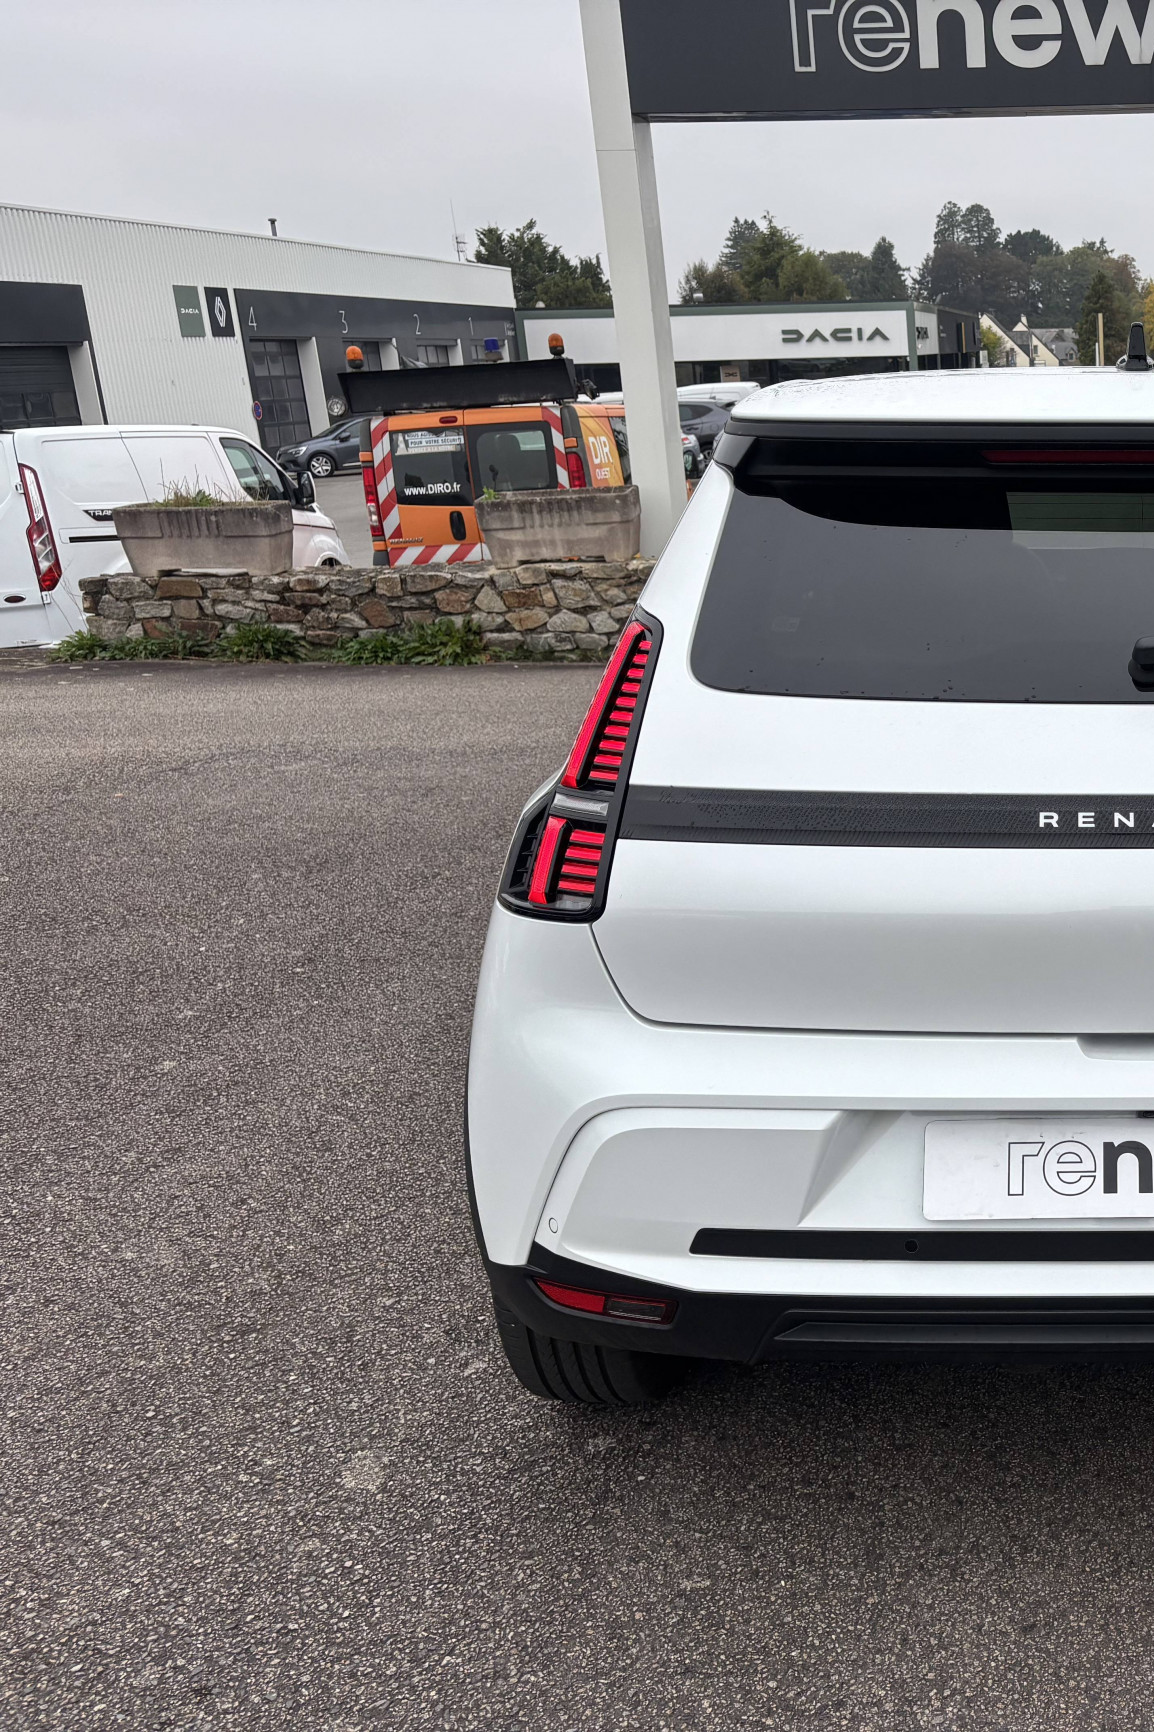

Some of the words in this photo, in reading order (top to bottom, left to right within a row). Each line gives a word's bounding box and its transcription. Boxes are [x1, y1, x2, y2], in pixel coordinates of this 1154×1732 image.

[248, 306, 257, 331] 4
[338, 310, 349, 334] 3
[413, 313, 421, 335] 2
[468, 316, 474, 336] 1
[781, 327, 890, 343] DACIA
[588, 436, 613, 464] DIR
[404, 482, 461, 496] www.DIRO.fr
